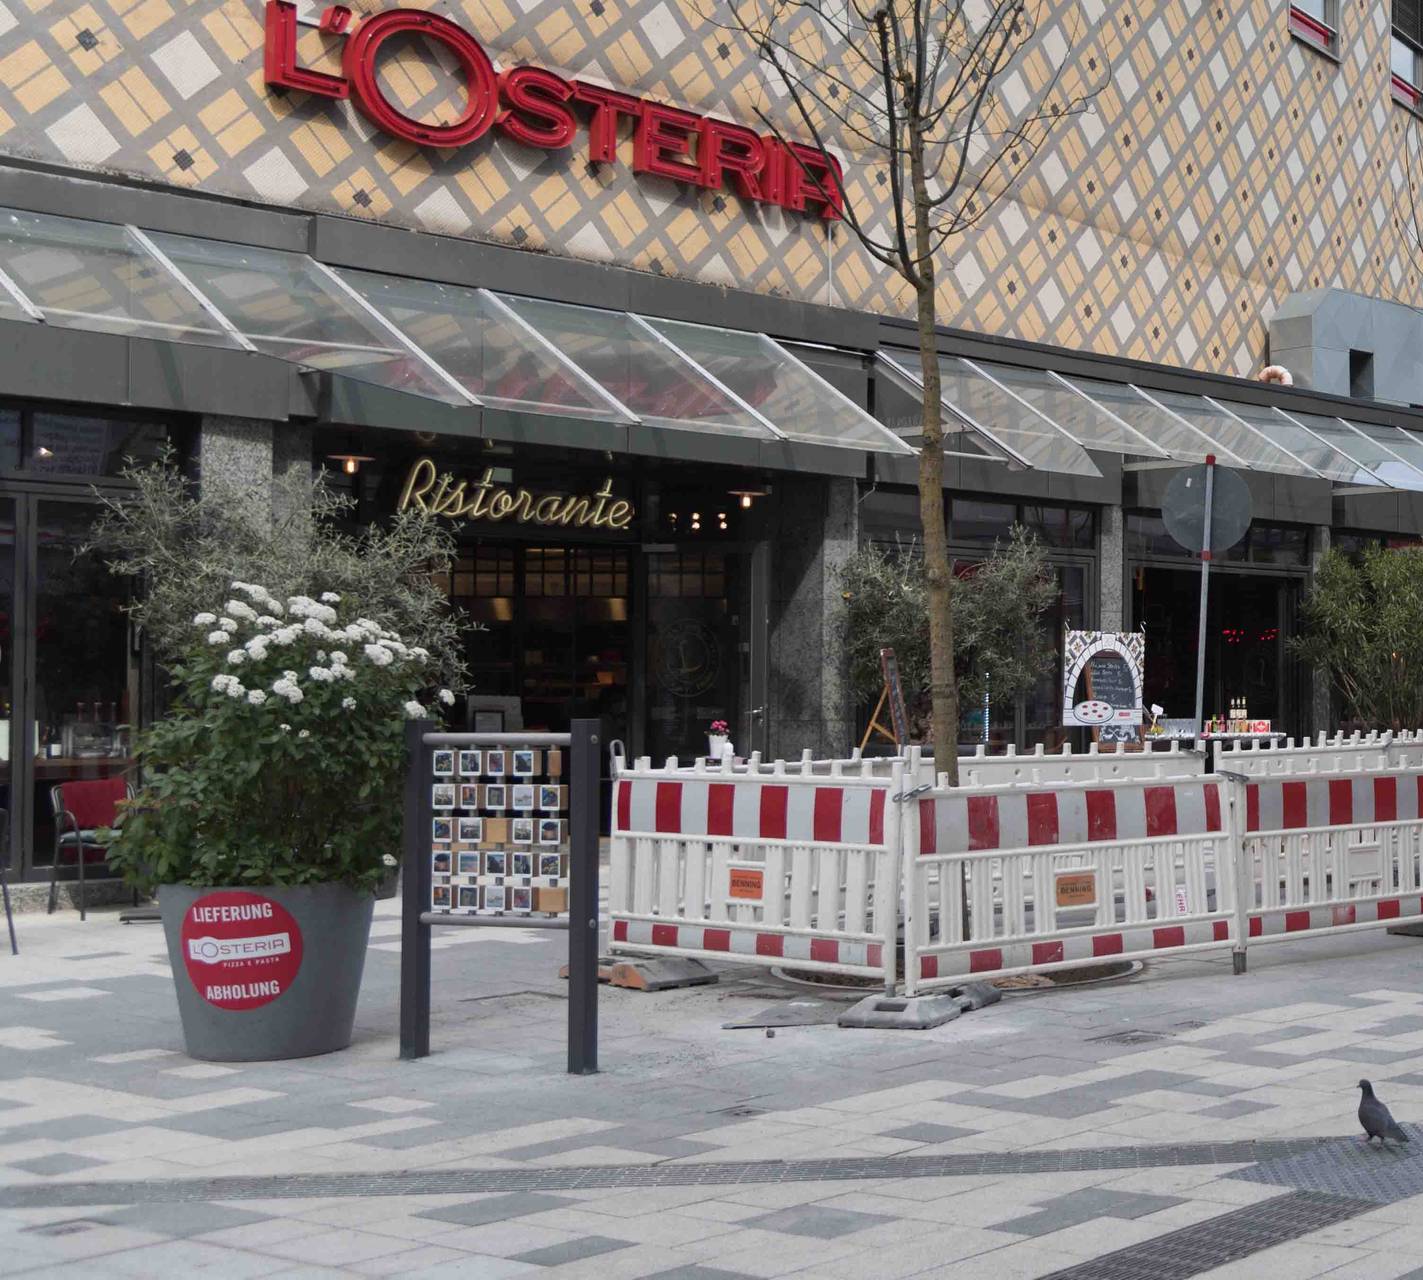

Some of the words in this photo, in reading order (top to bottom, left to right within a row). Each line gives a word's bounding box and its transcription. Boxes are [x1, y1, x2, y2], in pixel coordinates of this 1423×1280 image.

[264, 0, 844, 221] L'OSTERIA
[399, 456, 635, 530] Ristorante
[192, 902, 273, 923] LIEFERUNG
[206, 979, 281, 1001] ABHOLUNG
